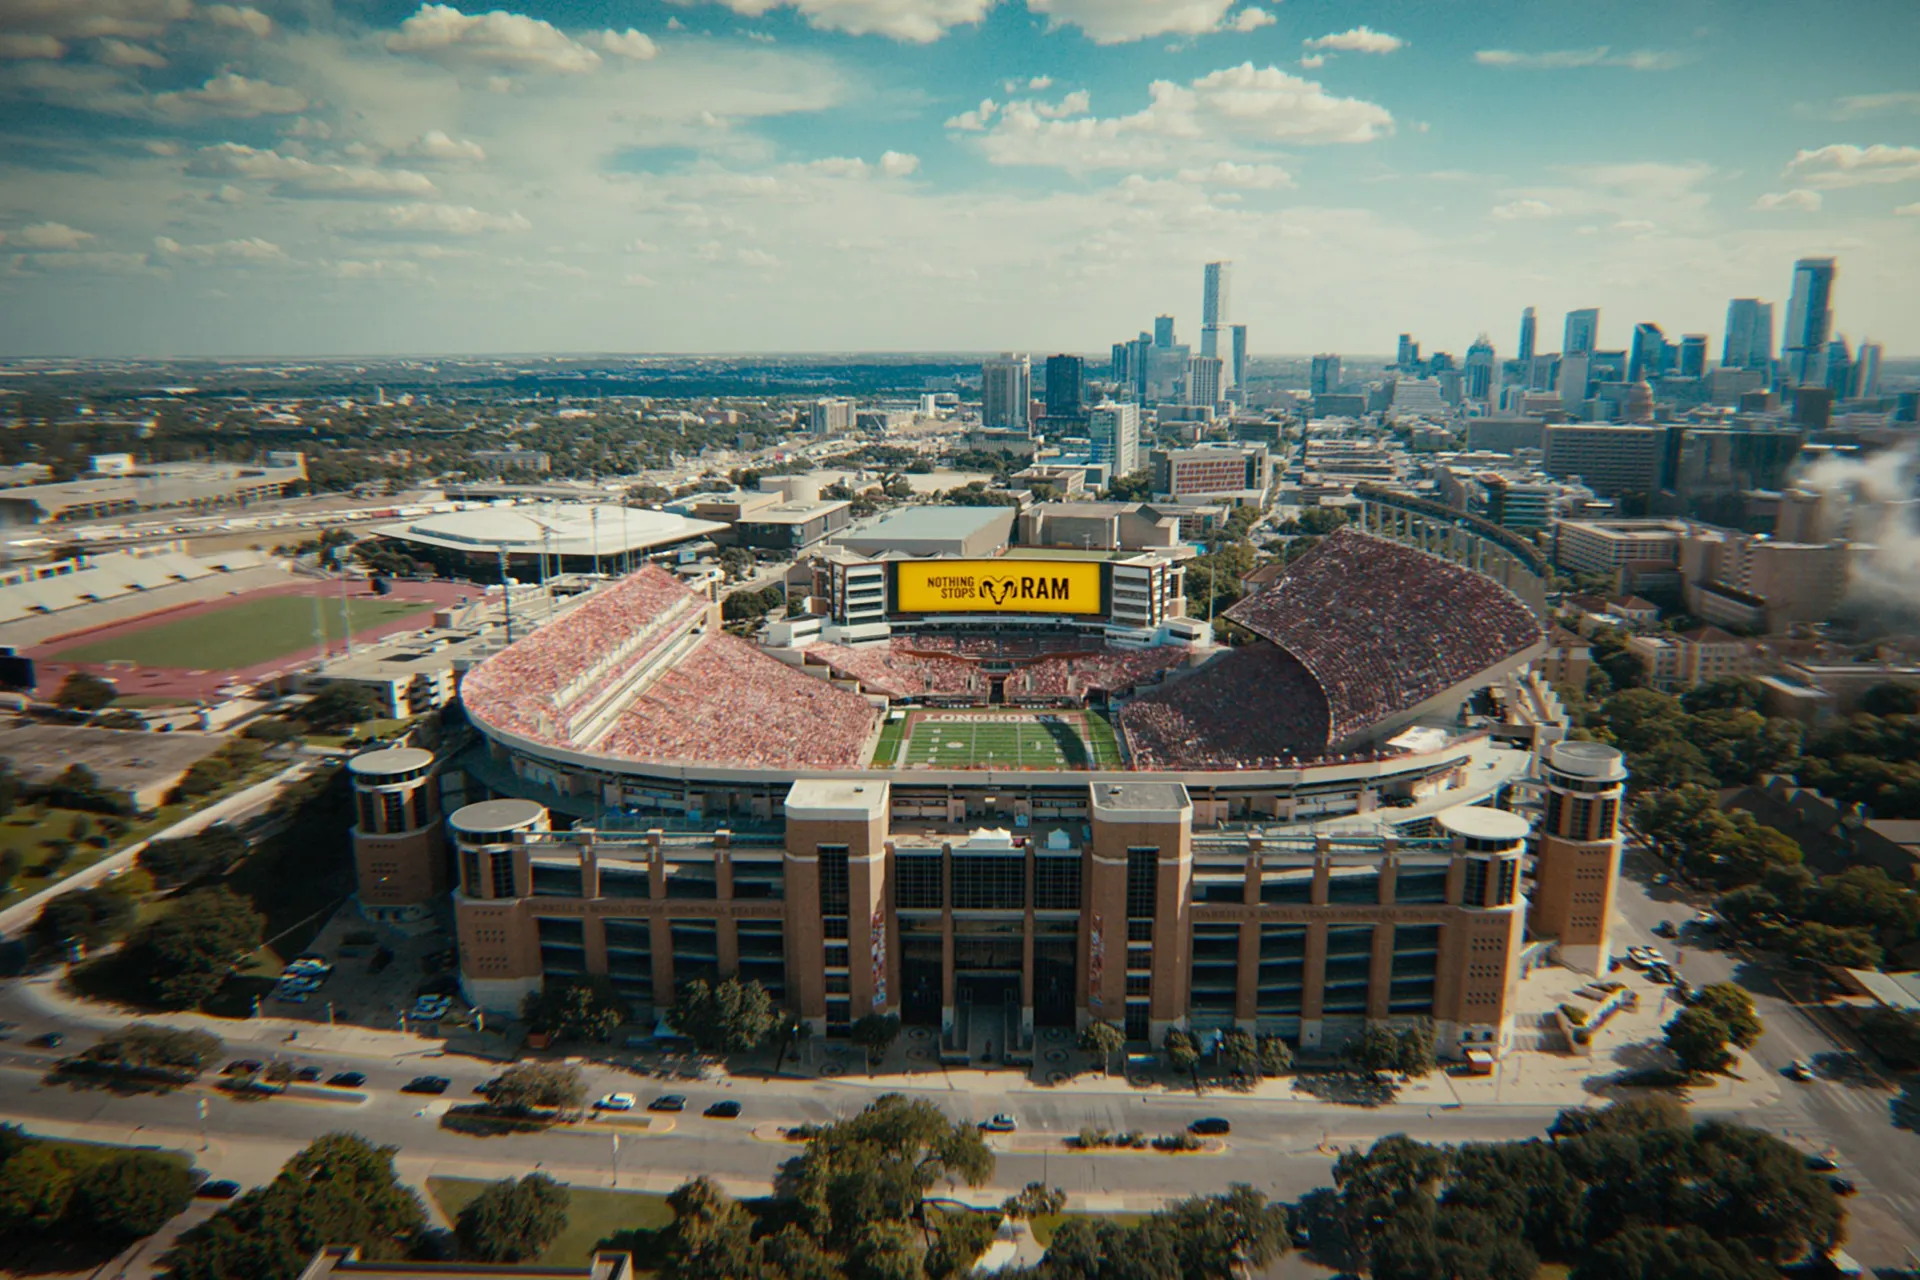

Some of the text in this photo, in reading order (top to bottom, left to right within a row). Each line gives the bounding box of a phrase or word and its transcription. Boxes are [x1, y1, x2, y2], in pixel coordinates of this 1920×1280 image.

[927, 576, 975, 588] NOTHING
[1020, 577, 1070, 600] RAM
[940, 587, 976, 600] STOPS
